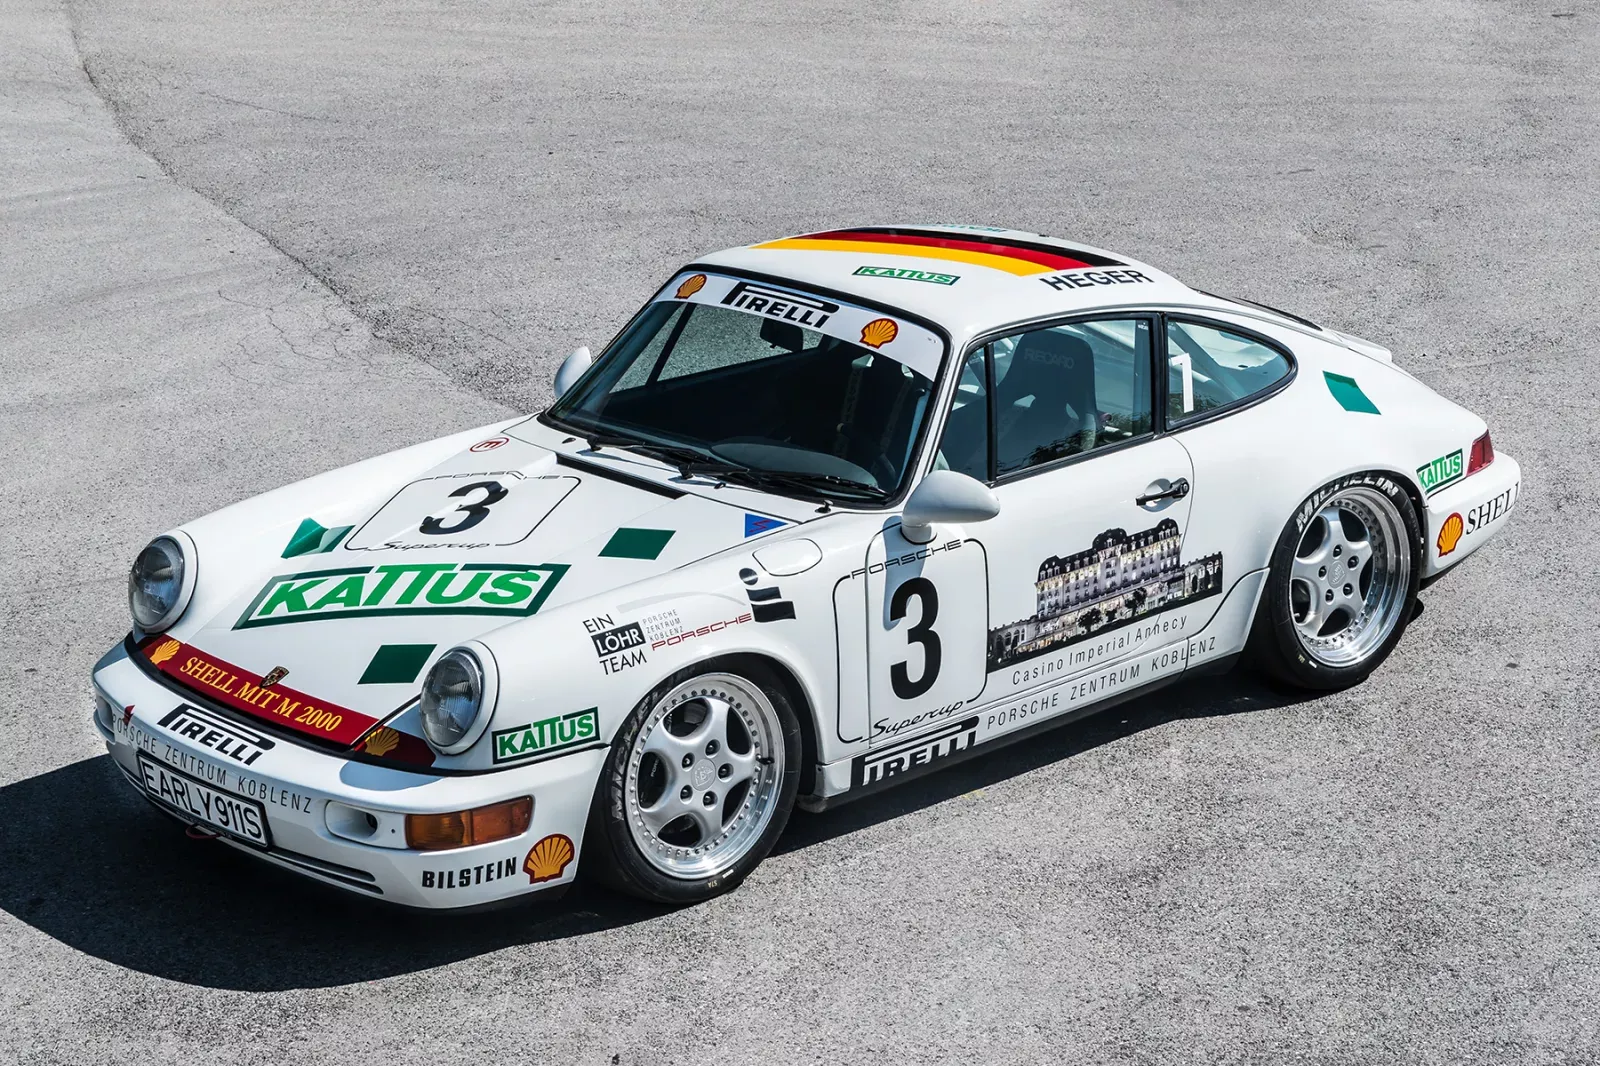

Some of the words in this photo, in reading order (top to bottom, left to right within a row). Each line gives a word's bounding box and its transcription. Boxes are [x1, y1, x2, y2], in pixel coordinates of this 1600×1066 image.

[860, 267, 953, 284] KATTUS
[1040, 270, 1154, 291] HEGER
[720, 281, 840, 329] PIRELLI
[1023, 348, 1075, 370] RECARO
[1418, 454, 1461, 488] KATTUS
[419, 481, 508, 535] 3
[364, 541, 491, 551] Supercup
[851, 539, 962, 579] PORSCHE
[256, 563, 542, 616] KATTUS
[582, 613, 615, 634] EIN
[643, 609, 677, 625] PORSCHE
[646, 618, 681, 634] ZENTRUM
[649, 626, 684, 642] KOBLENZ
[651, 613, 752, 651] PORSCHE
[595, 627, 643, 654] LÖHR
[890, 577, 942, 700] 3
[1012, 658, 1064, 686] Casino
[1069, 633, 1131, 666] Imperial
[1135, 614, 1188, 643] Annecy
[599, 649, 648, 676] TEAM
[180, 656, 238, 693] SHELL
[233, 681, 281, 709] MIT
[273, 695, 306, 719] M
[298, 705, 343, 733] 2000
[987, 692, 1059, 730] PORSCHE
[1070, 664, 1140, 700] ZENTRUM
[1151, 636, 1216, 671] KOBLENZ
[157, 702, 276, 766] PIRELLI
[498, 713, 594, 757] KATTUS
[860, 701, 964, 742] Supercup
[112, 713, 157, 754] PORSCHE
[165, 745, 227, 786] ZENTRUM
[238, 775, 311, 814] KOBLENZ
[851, 716, 980, 787] PIRELLI
[422, 856, 517, 889] BILSTEIN
